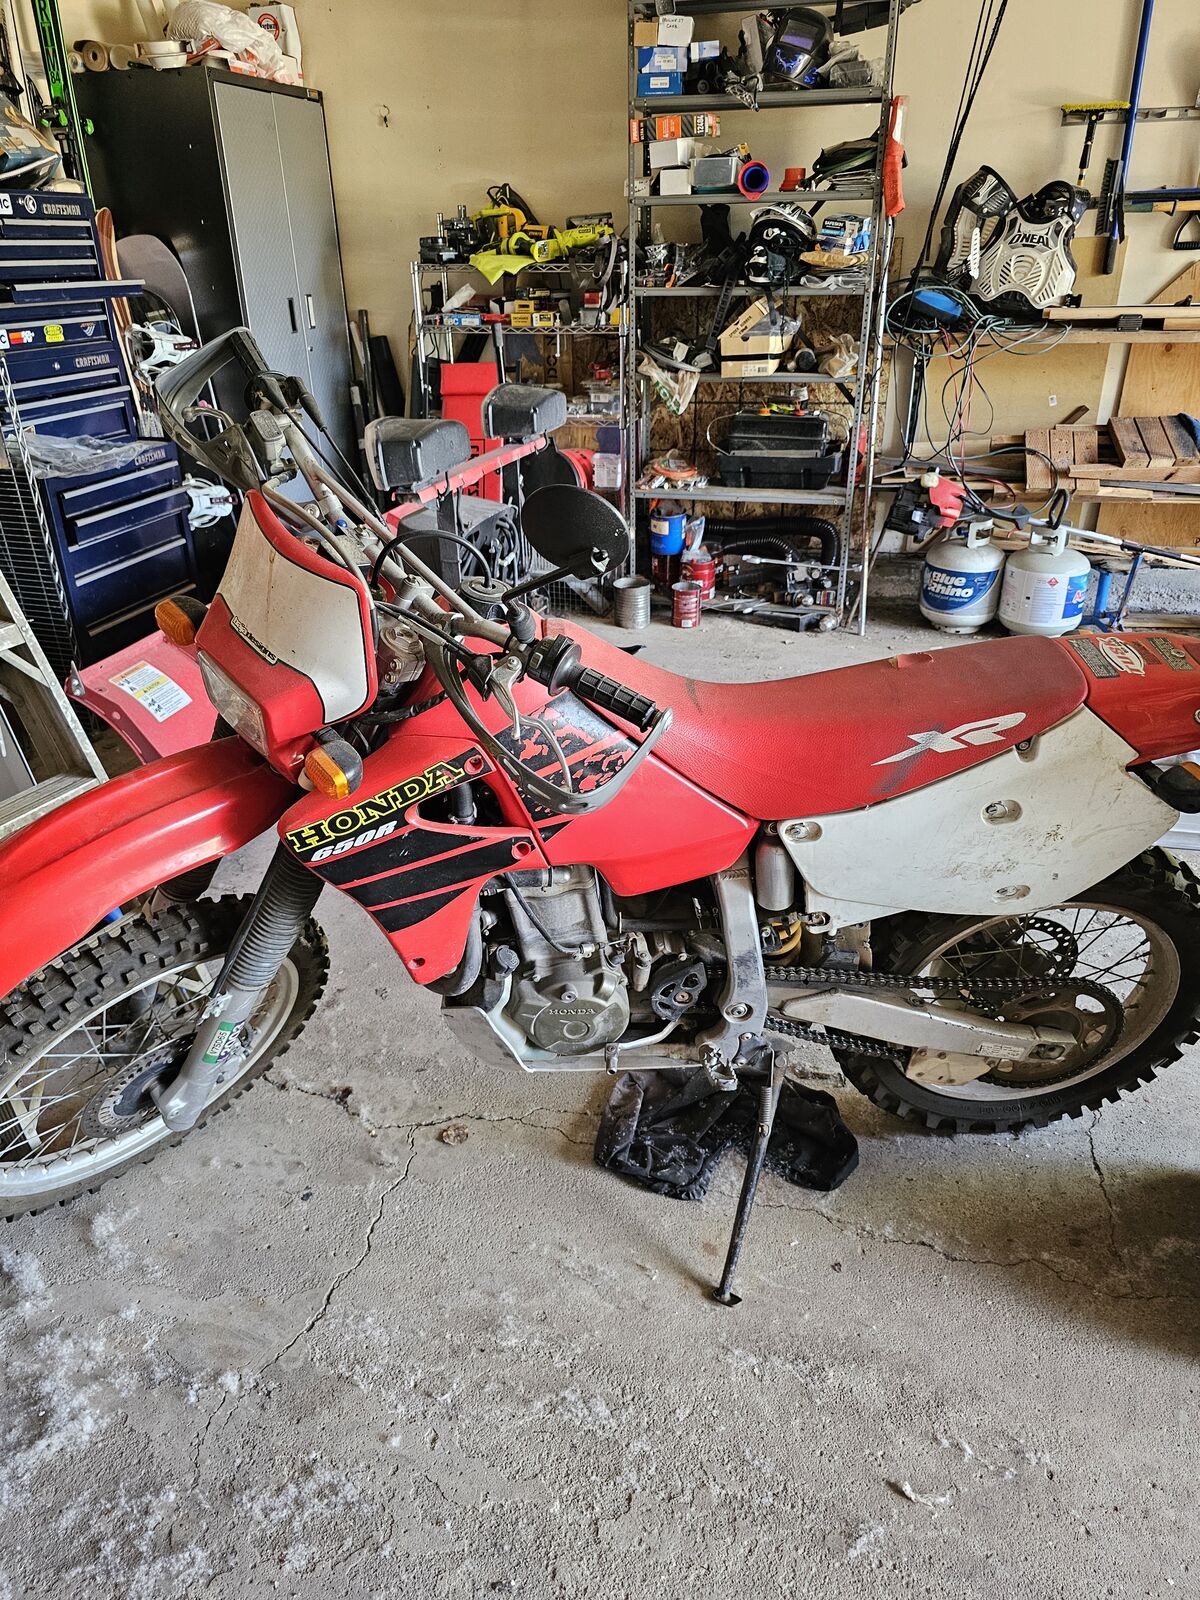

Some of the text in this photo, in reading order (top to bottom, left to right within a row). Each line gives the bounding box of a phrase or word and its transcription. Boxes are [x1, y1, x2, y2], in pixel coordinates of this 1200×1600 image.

[50, 72, 60, 84] 84
[42, 203, 82, 216] CRAFTSMAN
[74, 353, 111, 368] CRAFTSMAN
[931, 571, 967, 587] Blue
[926, 582, 974, 598] Rhino
[870, 712, 1027, 766] XR
[285, 761, 465, 853] HONDA
[310, 820, 398, 862] 650R
[549, 1006, 596, 1015] HONDA
